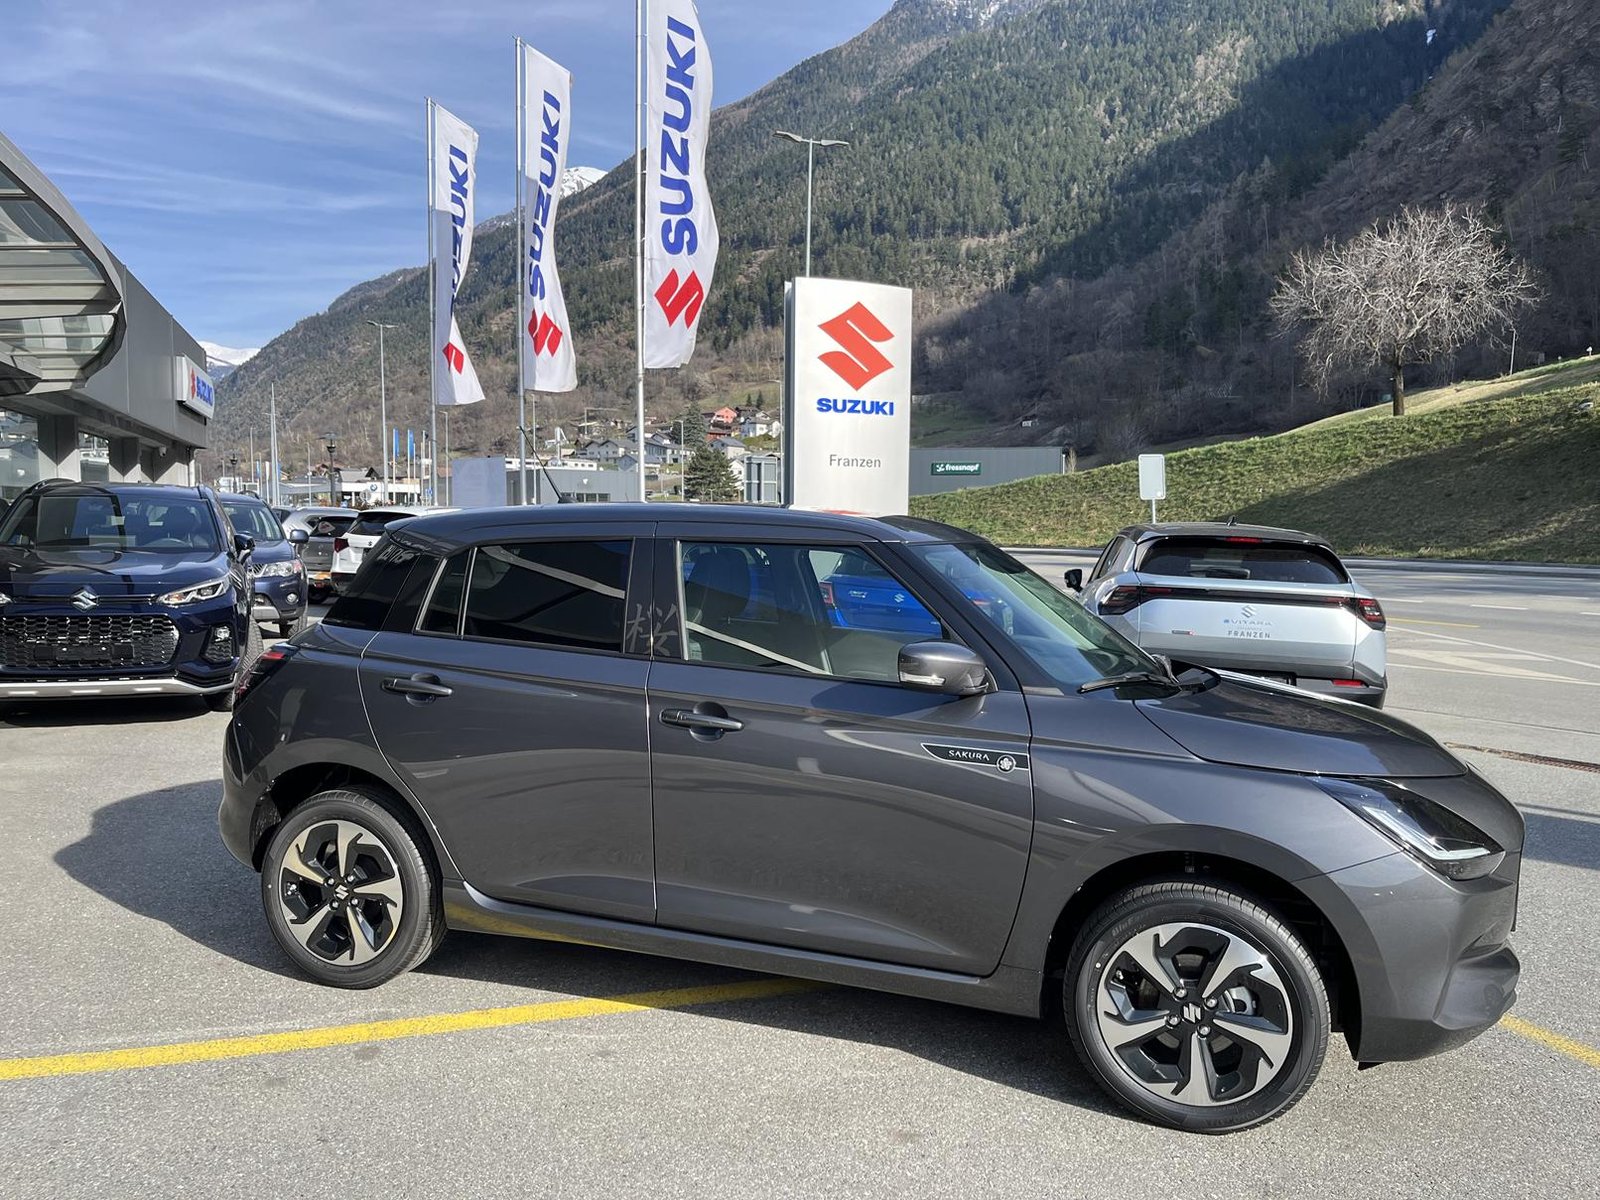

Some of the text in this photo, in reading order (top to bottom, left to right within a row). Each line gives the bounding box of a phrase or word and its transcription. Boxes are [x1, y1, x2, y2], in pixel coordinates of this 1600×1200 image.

[660, 15, 698, 256] SUZUKI
[529, 90, 561, 300] SUZUKI
[816, 398, 894, 416] SUZUKI
[829, 454, 881, 468] Franzen
[945, 463, 980, 472] fressnapf
[1227, 630, 1271, 639] FRANZEN
[948, 750, 990, 761] SAKURA
